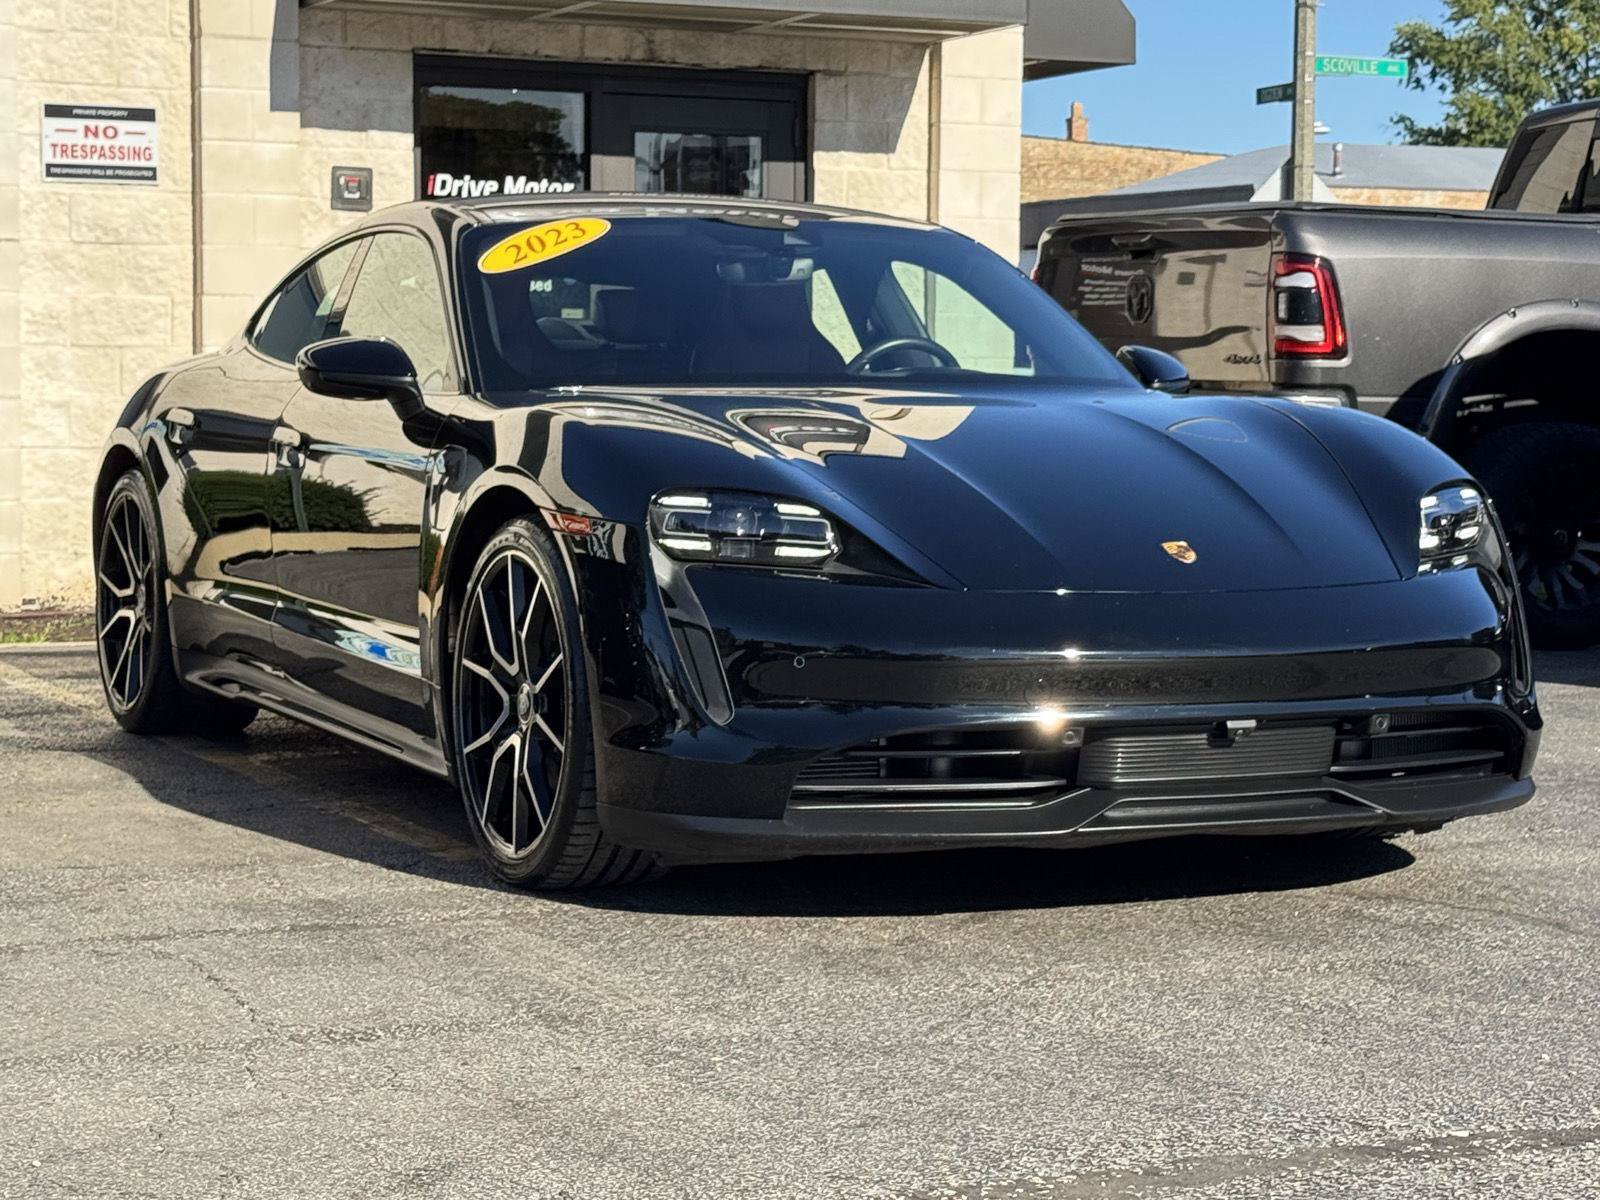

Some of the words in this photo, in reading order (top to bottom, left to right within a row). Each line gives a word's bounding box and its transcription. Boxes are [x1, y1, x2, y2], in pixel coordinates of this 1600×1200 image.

[1322, 57, 1379, 74] SCOVILLE
[83, 125, 118, 139] NO
[50, 143, 153, 161] TRESPASSING
[427, 173, 499, 198] iDrive
[505, 221, 587, 264] 2023
